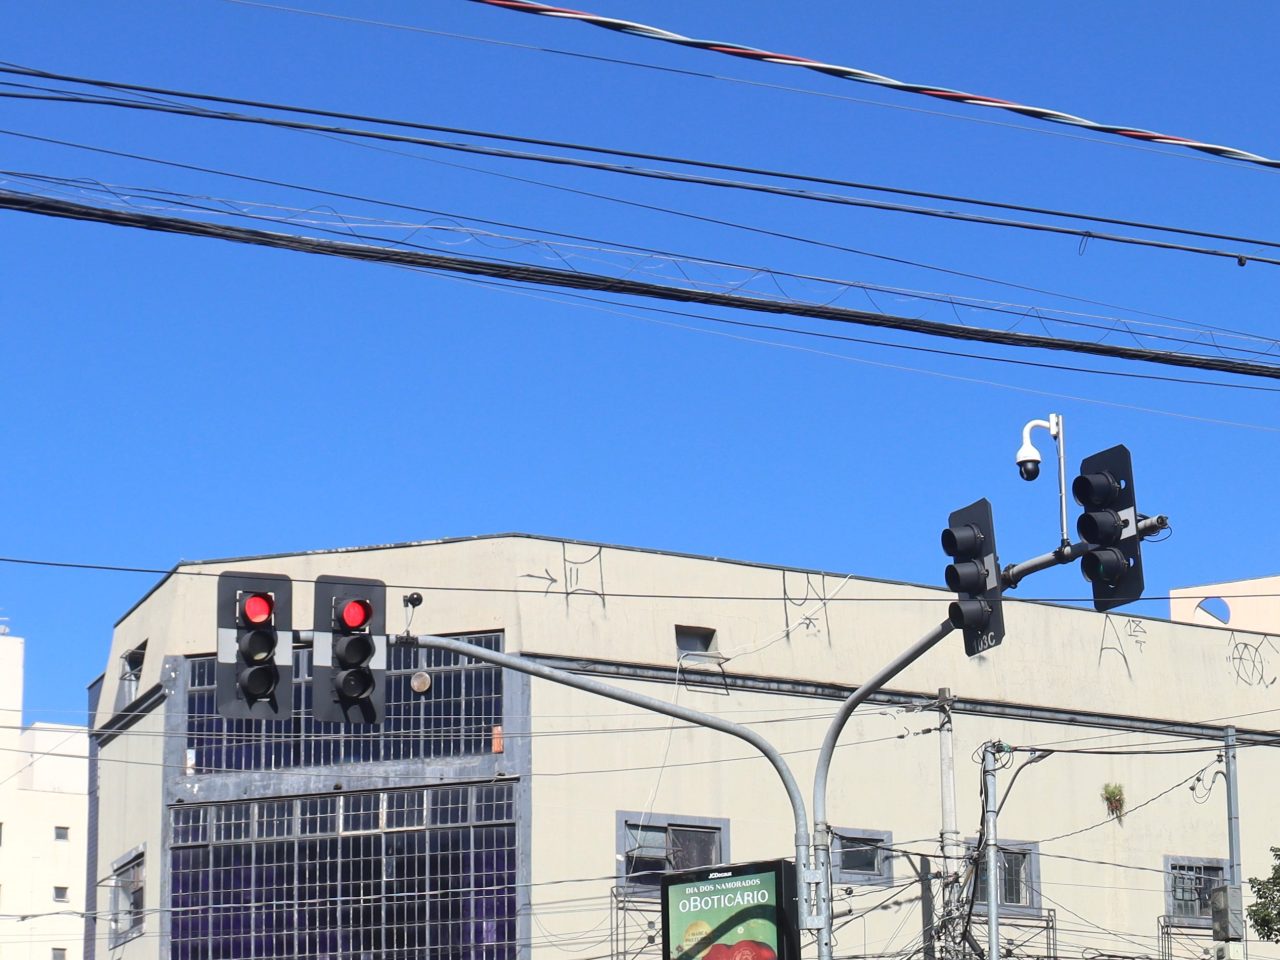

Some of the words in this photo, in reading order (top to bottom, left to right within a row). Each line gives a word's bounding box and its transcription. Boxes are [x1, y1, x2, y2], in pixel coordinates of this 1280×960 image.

[685, 886, 698, 894] DIA
[700, 884, 715, 893] DOS
[716, 878, 761, 890] NAMORADOS
